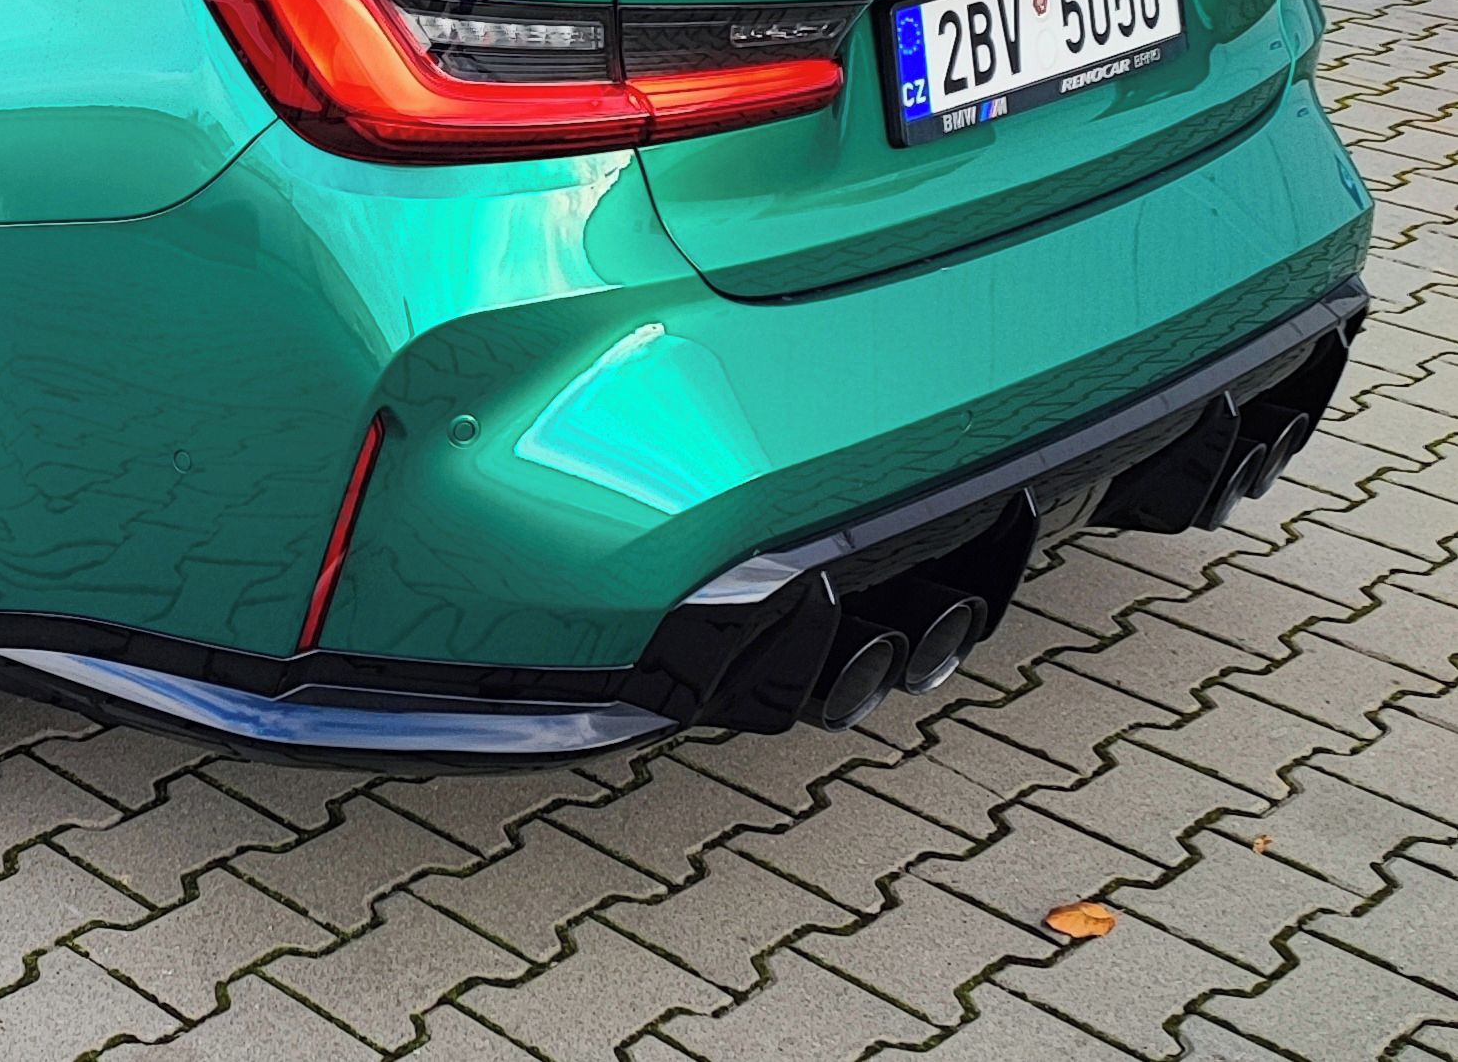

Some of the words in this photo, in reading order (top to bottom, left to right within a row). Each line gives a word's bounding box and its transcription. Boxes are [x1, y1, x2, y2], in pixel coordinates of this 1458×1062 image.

[1061, 58, 1132, 94] RENOCAR
[902, 78, 927, 108] CZ
[942, 105, 977, 134] BMW
